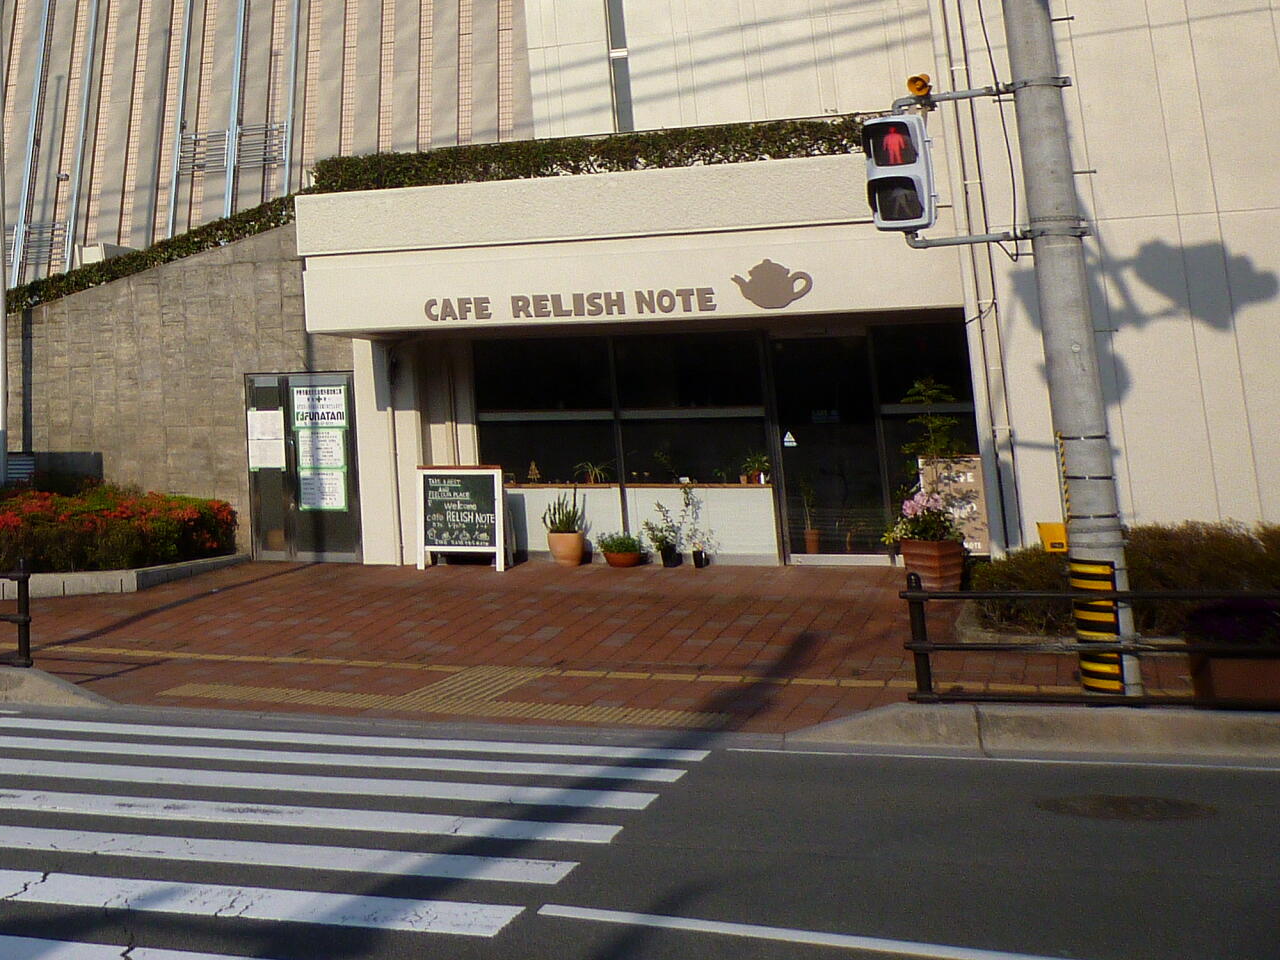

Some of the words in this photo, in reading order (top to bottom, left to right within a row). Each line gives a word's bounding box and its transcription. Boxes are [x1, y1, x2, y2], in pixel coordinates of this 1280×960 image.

[424, 296, 493, 322] CAFE
[511, 291, 625, 319] RELISH
[634, 287, 718, 315] NOTE
[443, 500, 477, 510] Welcome
[446, 511, 474, 522] RELISH
[475, 513, 495, 524] NOTE
